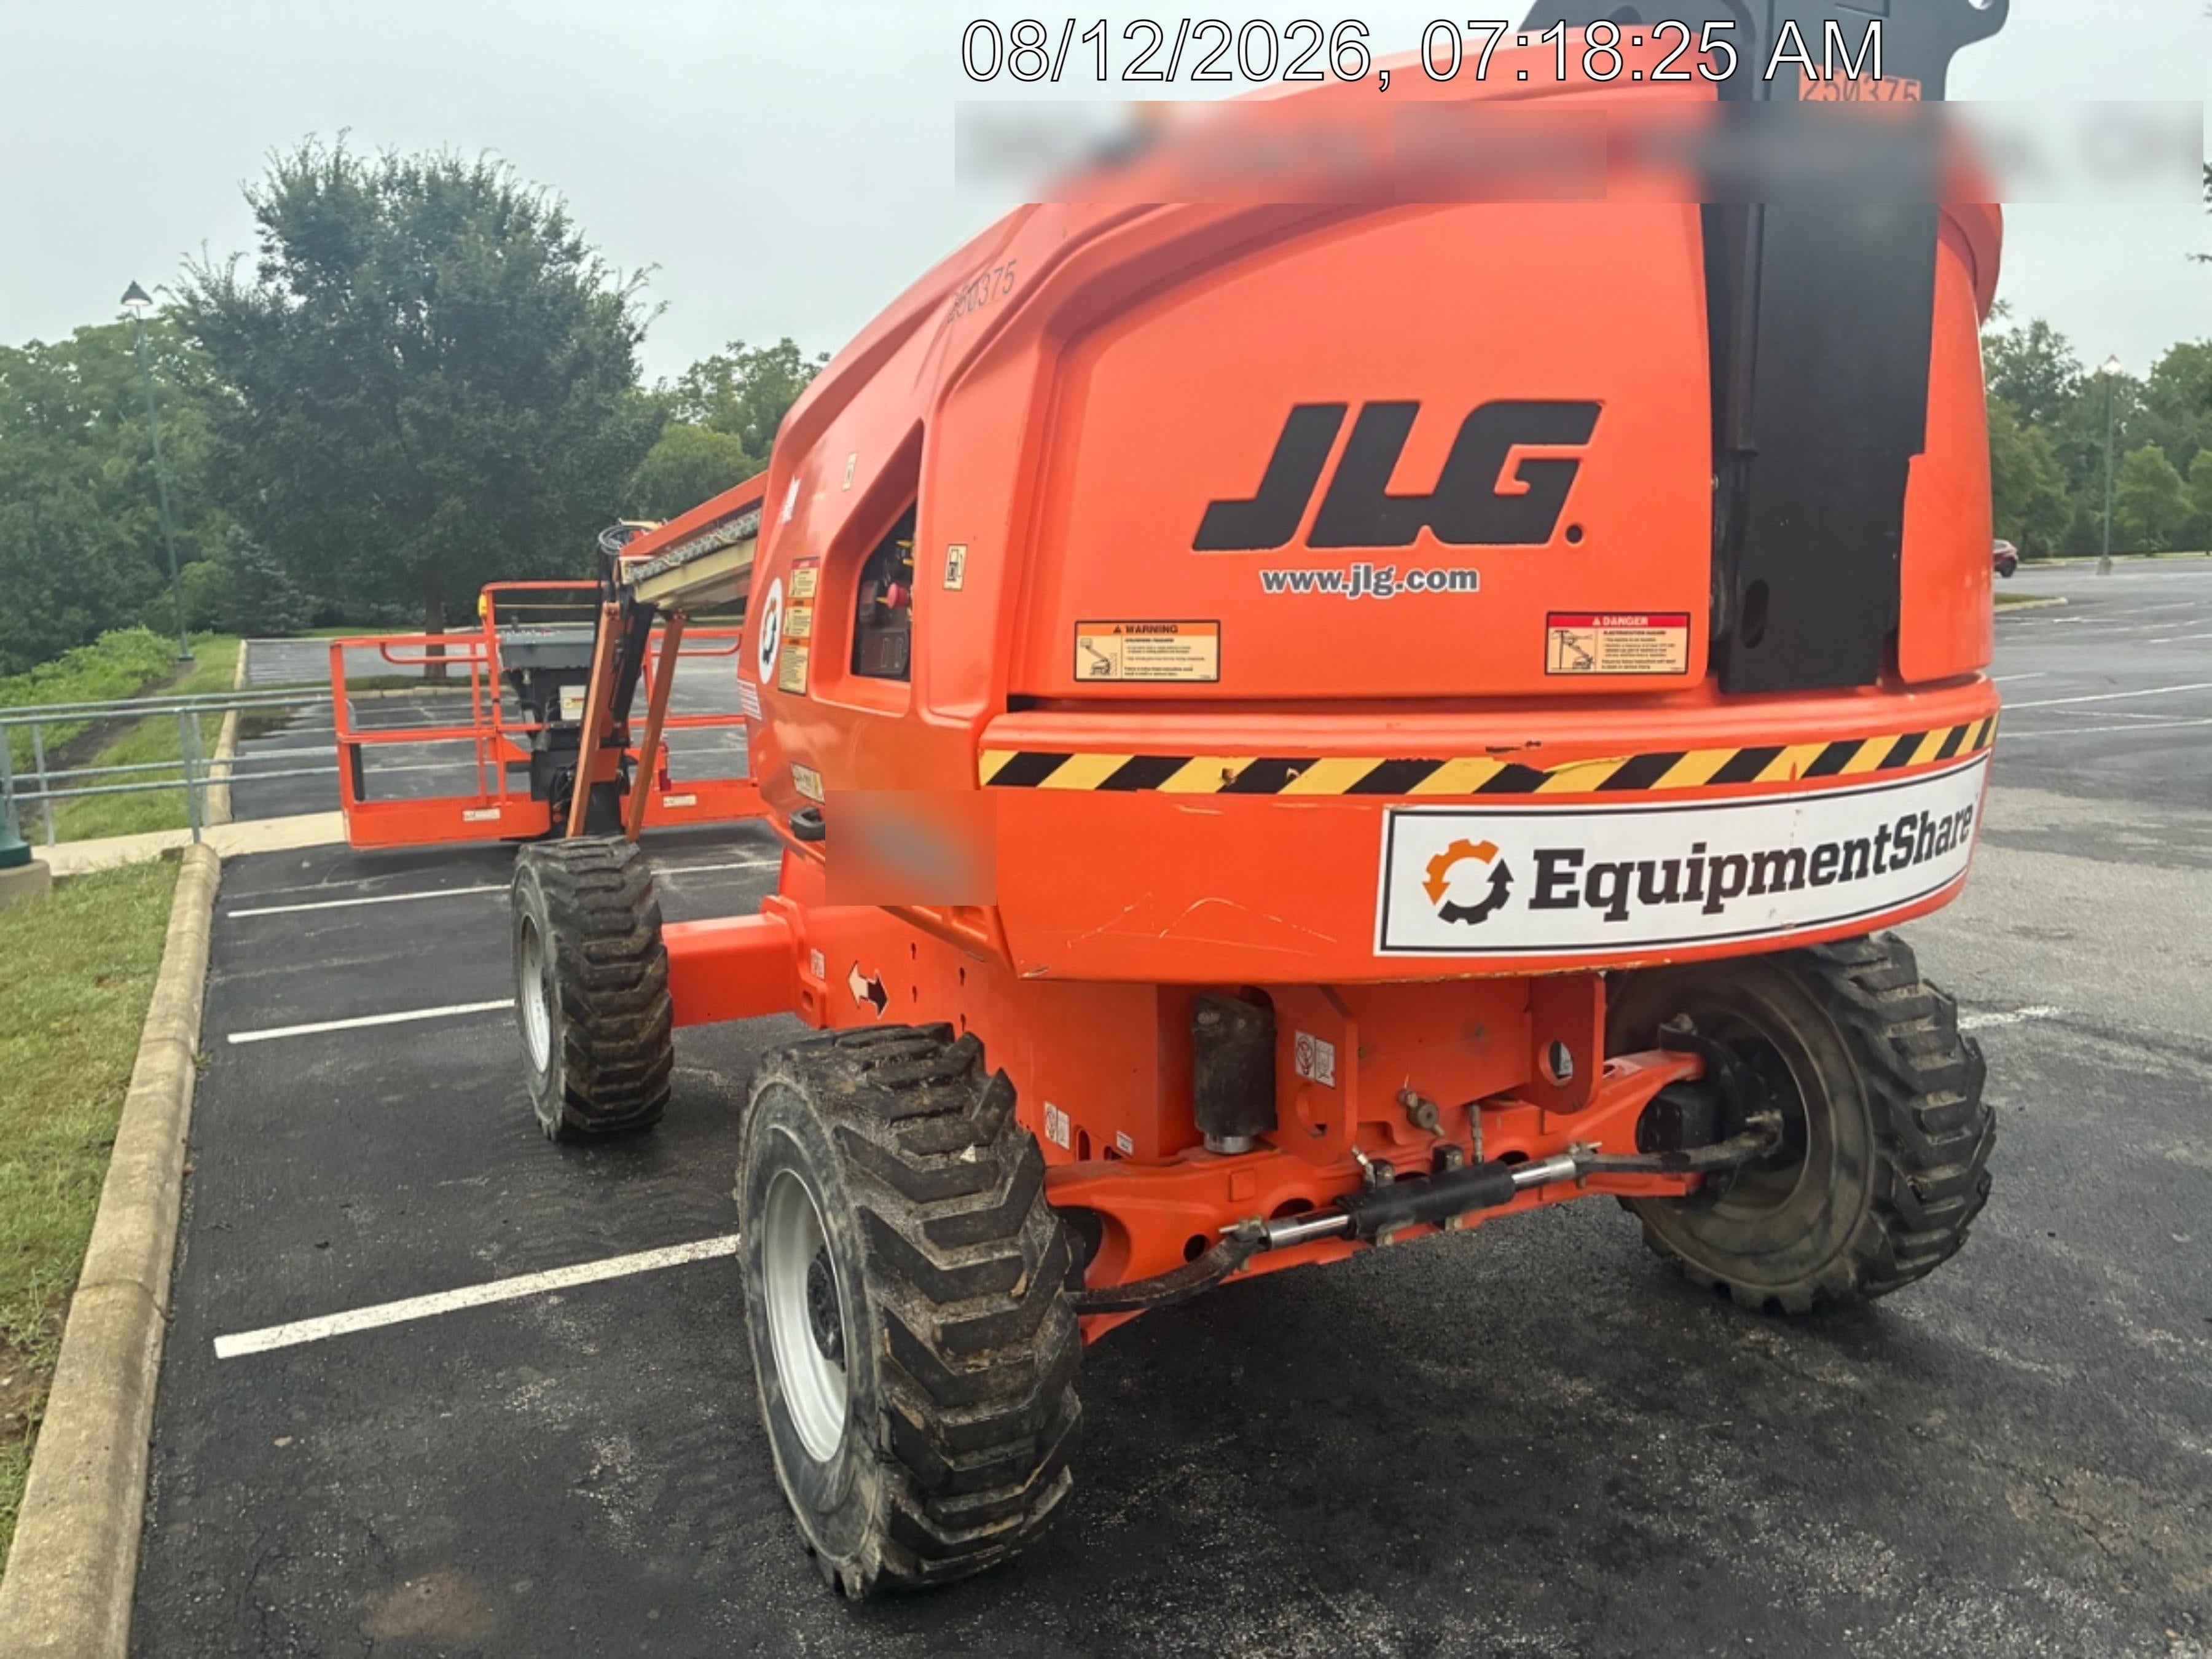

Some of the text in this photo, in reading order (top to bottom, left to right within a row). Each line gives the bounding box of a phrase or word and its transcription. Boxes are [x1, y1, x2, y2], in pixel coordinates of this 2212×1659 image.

[1261, 564, 1478, 598] www.jlg.com
[1125, 624, 1179, 633] WARNING
[1602, 616, 1649, 626] DANGER
[1528, 804, 1974, 923] EquipmentShare
